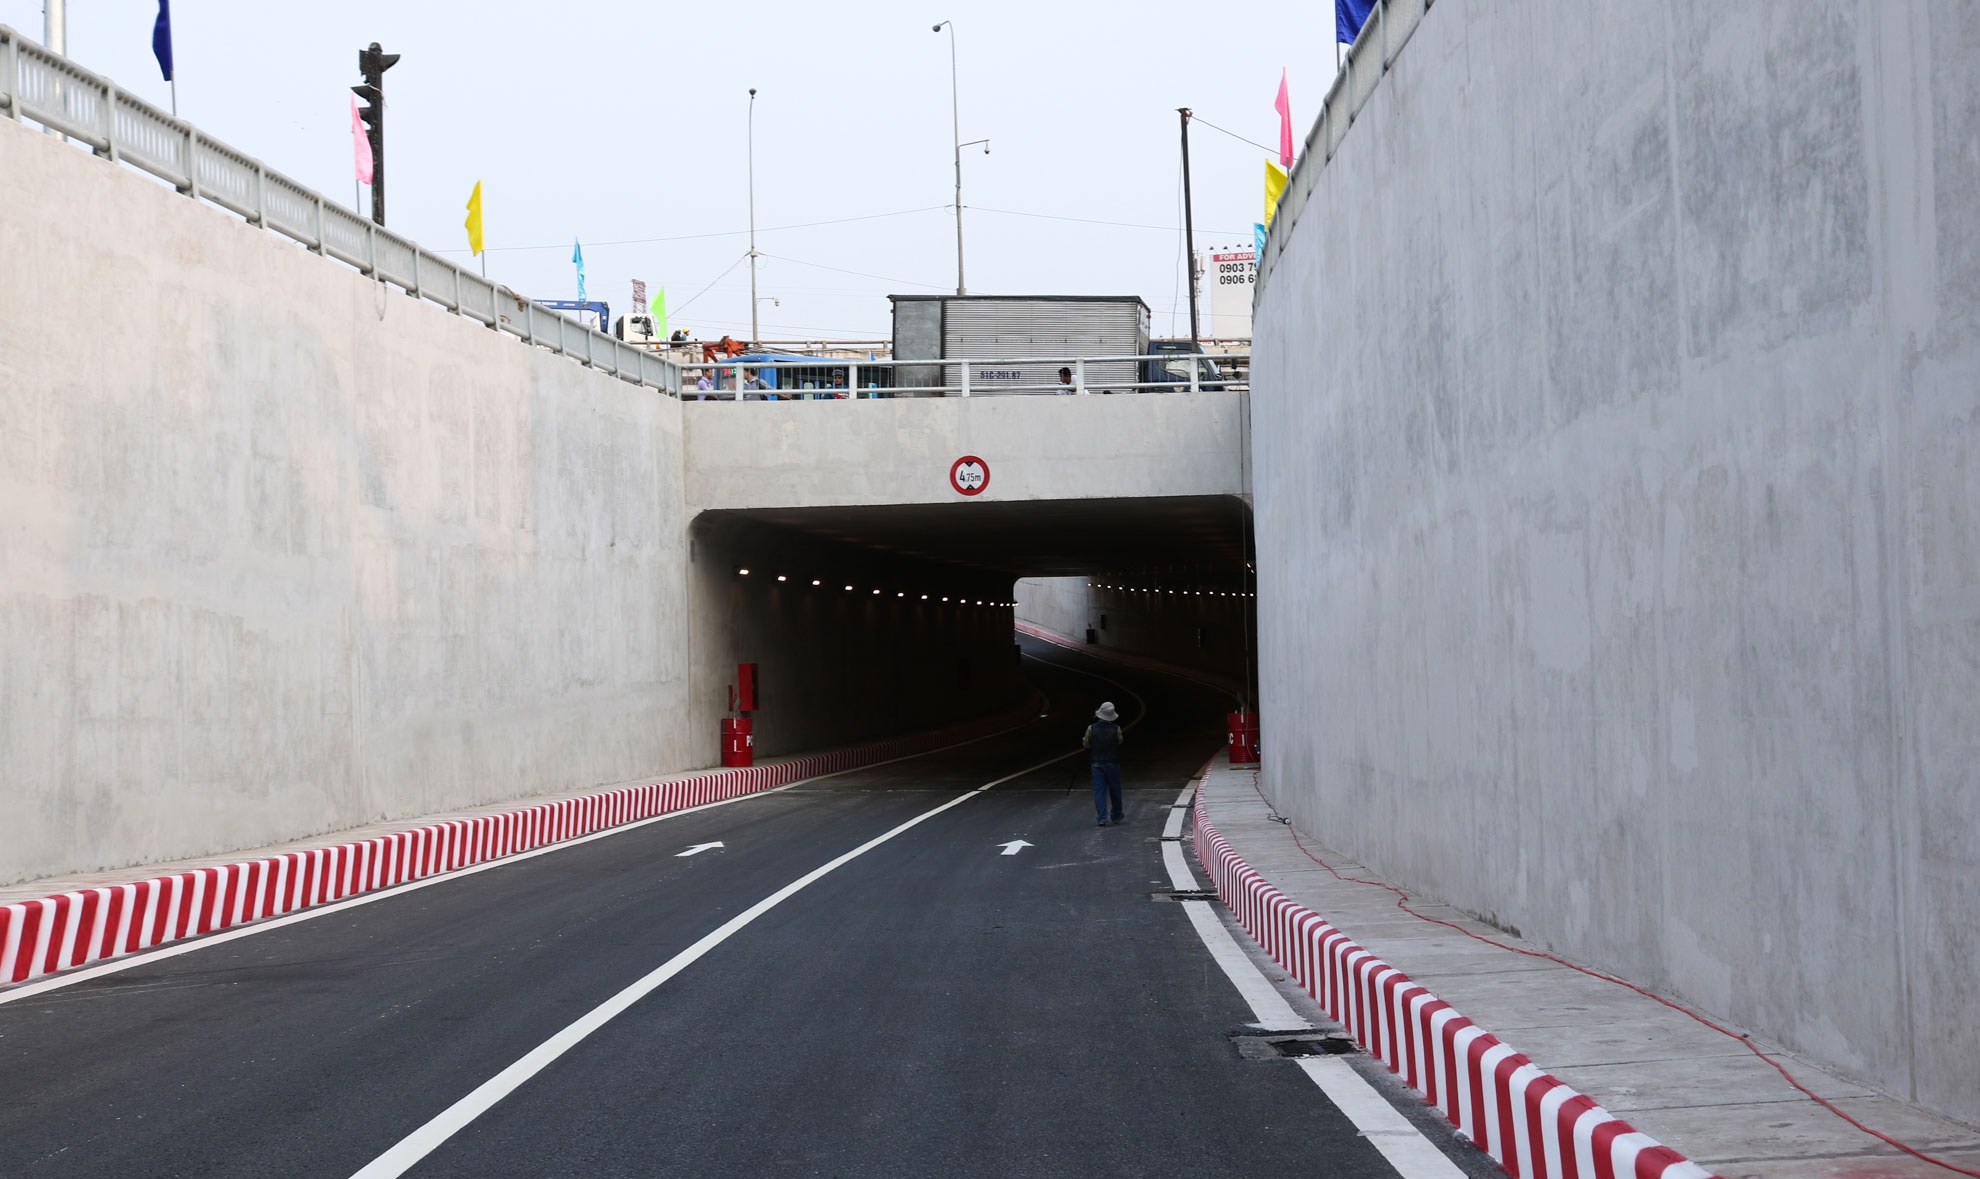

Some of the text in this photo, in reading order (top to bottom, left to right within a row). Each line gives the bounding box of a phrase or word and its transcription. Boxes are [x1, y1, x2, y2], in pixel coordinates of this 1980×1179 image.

[1219, 263, 1245, 273] 0903
[1220, 274, 1256, 285] 0906 6
